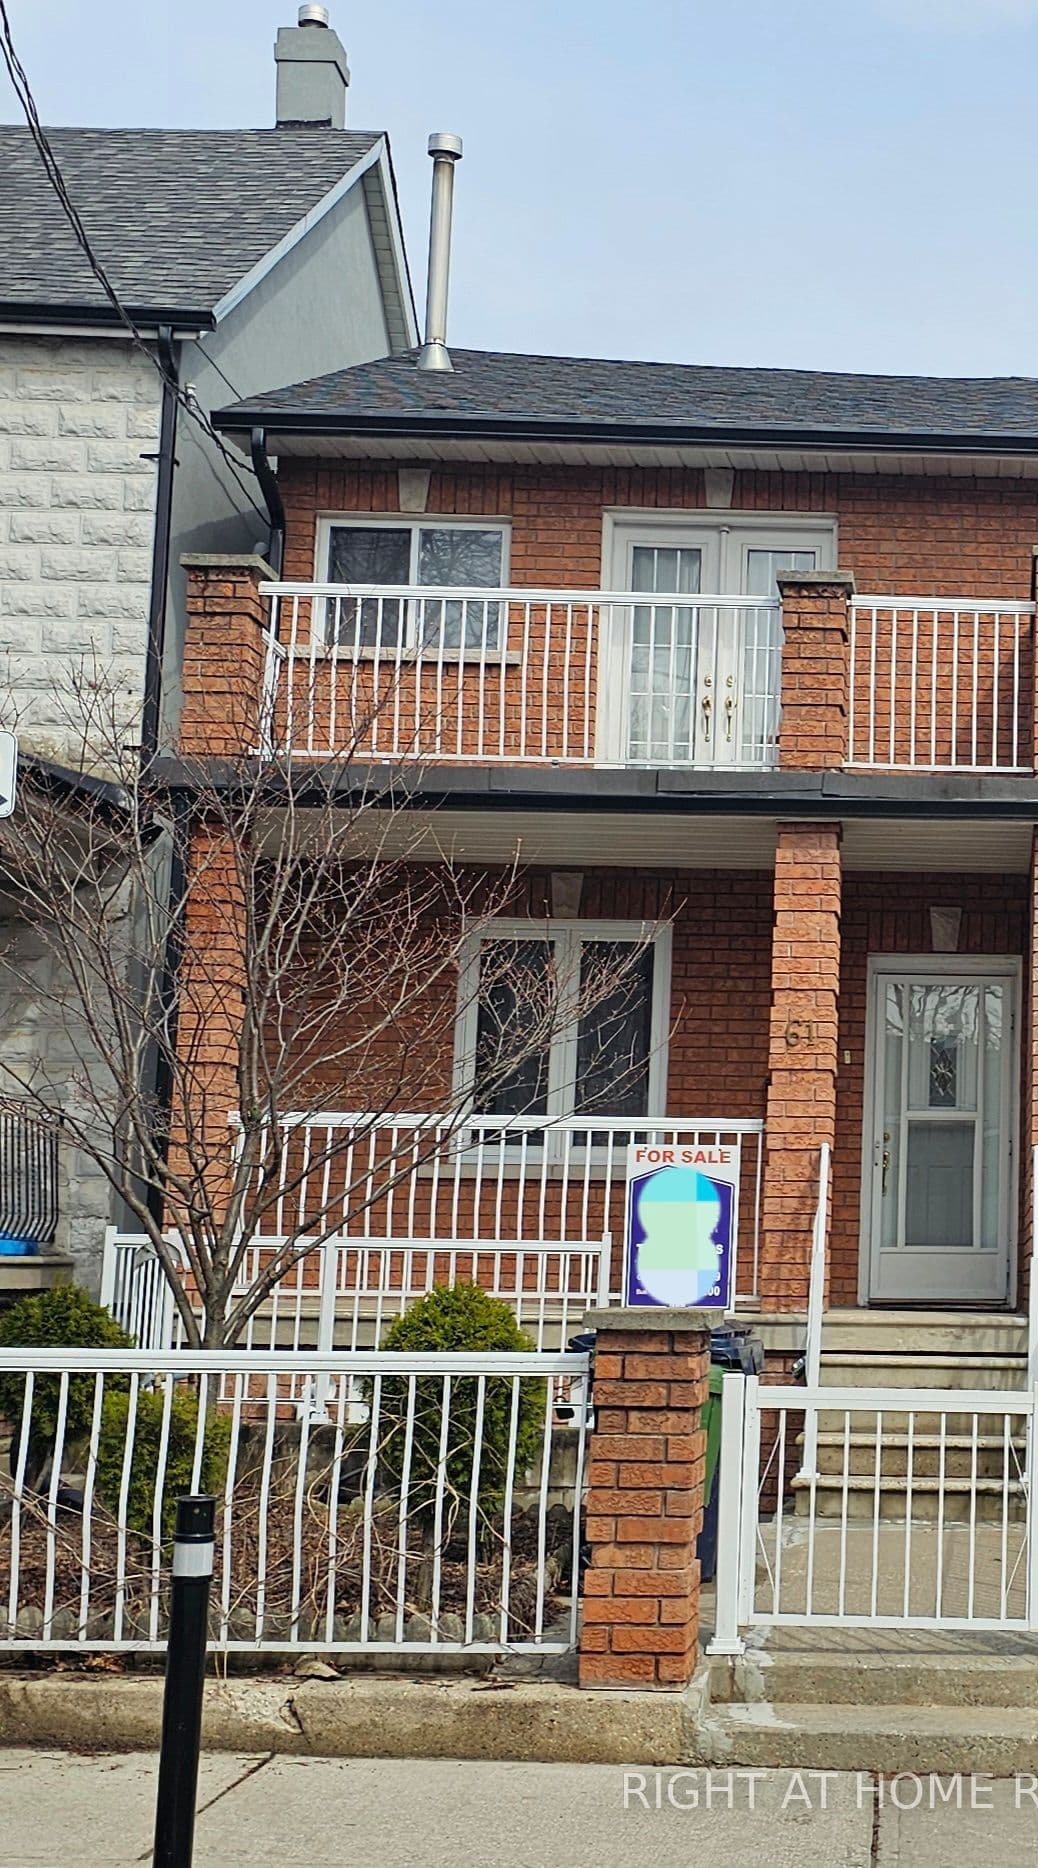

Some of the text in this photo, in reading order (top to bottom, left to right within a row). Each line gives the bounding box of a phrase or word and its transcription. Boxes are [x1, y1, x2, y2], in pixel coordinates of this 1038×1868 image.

[786, 1019, 815, 1047] 61
[636, 1150, 731, 1164] FOR SALE
